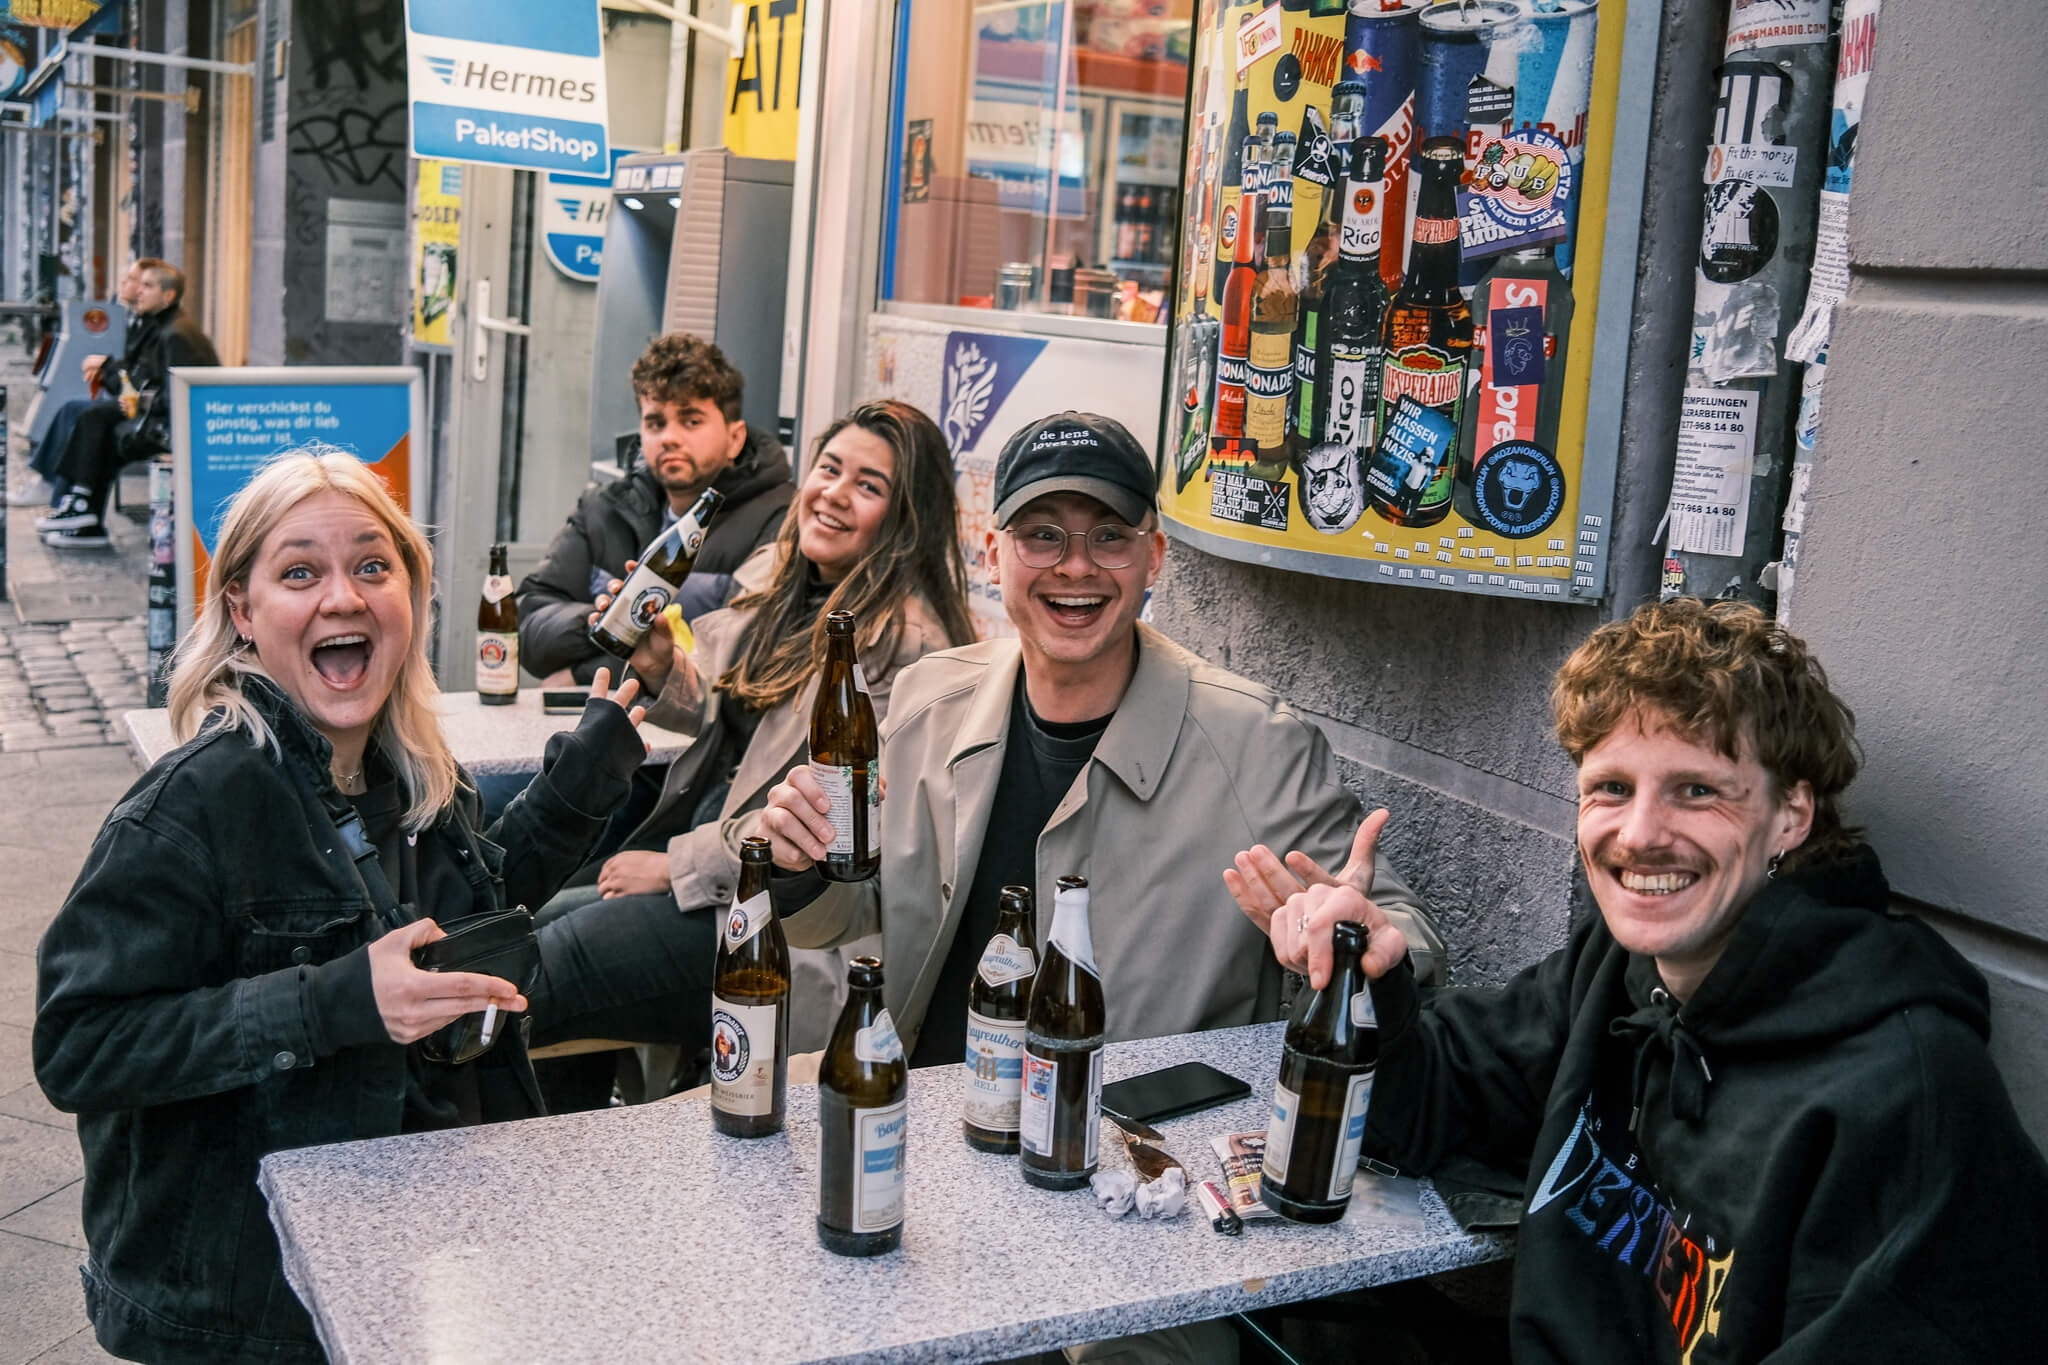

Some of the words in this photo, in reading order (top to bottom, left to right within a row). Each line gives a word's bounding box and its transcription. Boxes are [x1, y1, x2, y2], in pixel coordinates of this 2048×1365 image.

[464, 61, 596, 103] Hermes
[455, 118, 598, 162] PaketShop
[586, 201, 607, 223] H
[576, 244, 602, 266] Pa
[1383, 365, 1460, 406] DESPERADOS
[206, 401, 234, 414] Hier
[237, 401, 311, 414] verschickst
[313, 401, 331, 414] du
[1400, 398, 1422, 420] WIR
[264, 418, 291, 429] was
[294, 416, 312, 429] dir
[315, 416, 340, 429] lieb
[1393, 411, 1439, 445] HASSEN
[1714, 422, 1727, 432] 14
[1730, 423, 1745, 433] 80
[207, 432, 233, 444] und
[236, 432, 271, 444] teuer
[1032, 439, 1067, 451] loves
[1071, 438, 1099, 448] you
[1040, 430, 1057, 440] de
[1387, 426, 1416, 448] ALLE
[1381, 437, 1416, 465] NAZIS
[1706, 506, 1719, 515] 14
[1722, 507, 1736, 517] 80
